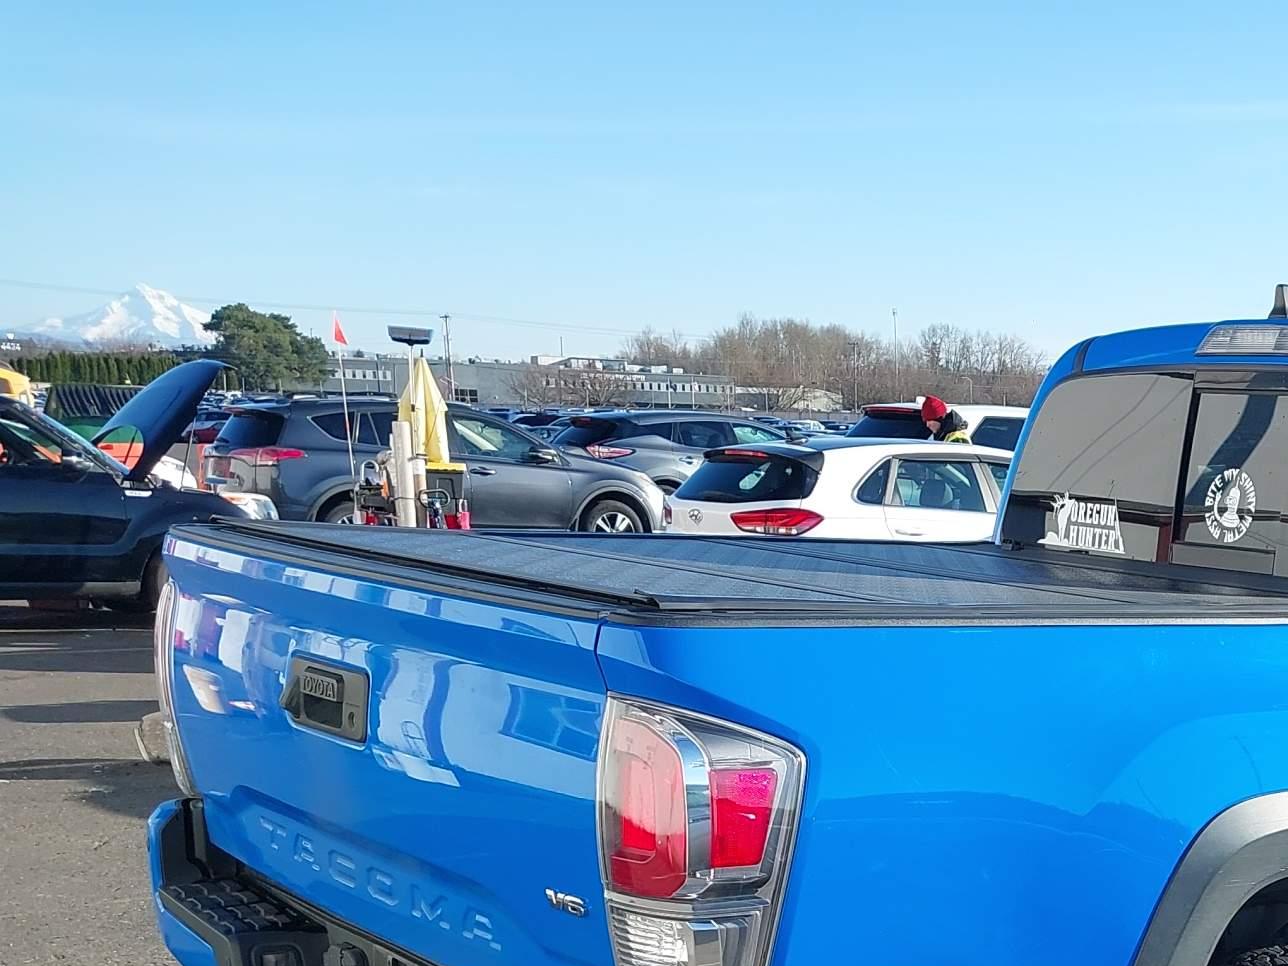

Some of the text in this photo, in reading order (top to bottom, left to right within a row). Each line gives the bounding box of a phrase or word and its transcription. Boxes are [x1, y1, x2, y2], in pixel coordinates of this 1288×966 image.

[1223, 468, 1240, 482] MY
[1205, 474, 1224, 507] BITE
[1240, 472, 1256, 514] SHINY
[1068, 525, 1116, 550] HUNTER
[1223, 515, 1253, 543] METAL
[303, 674, 336, 699] TOYOTA
[256, 814, 502, 952] TACOMA
[545, 887, 591, 918] V6
